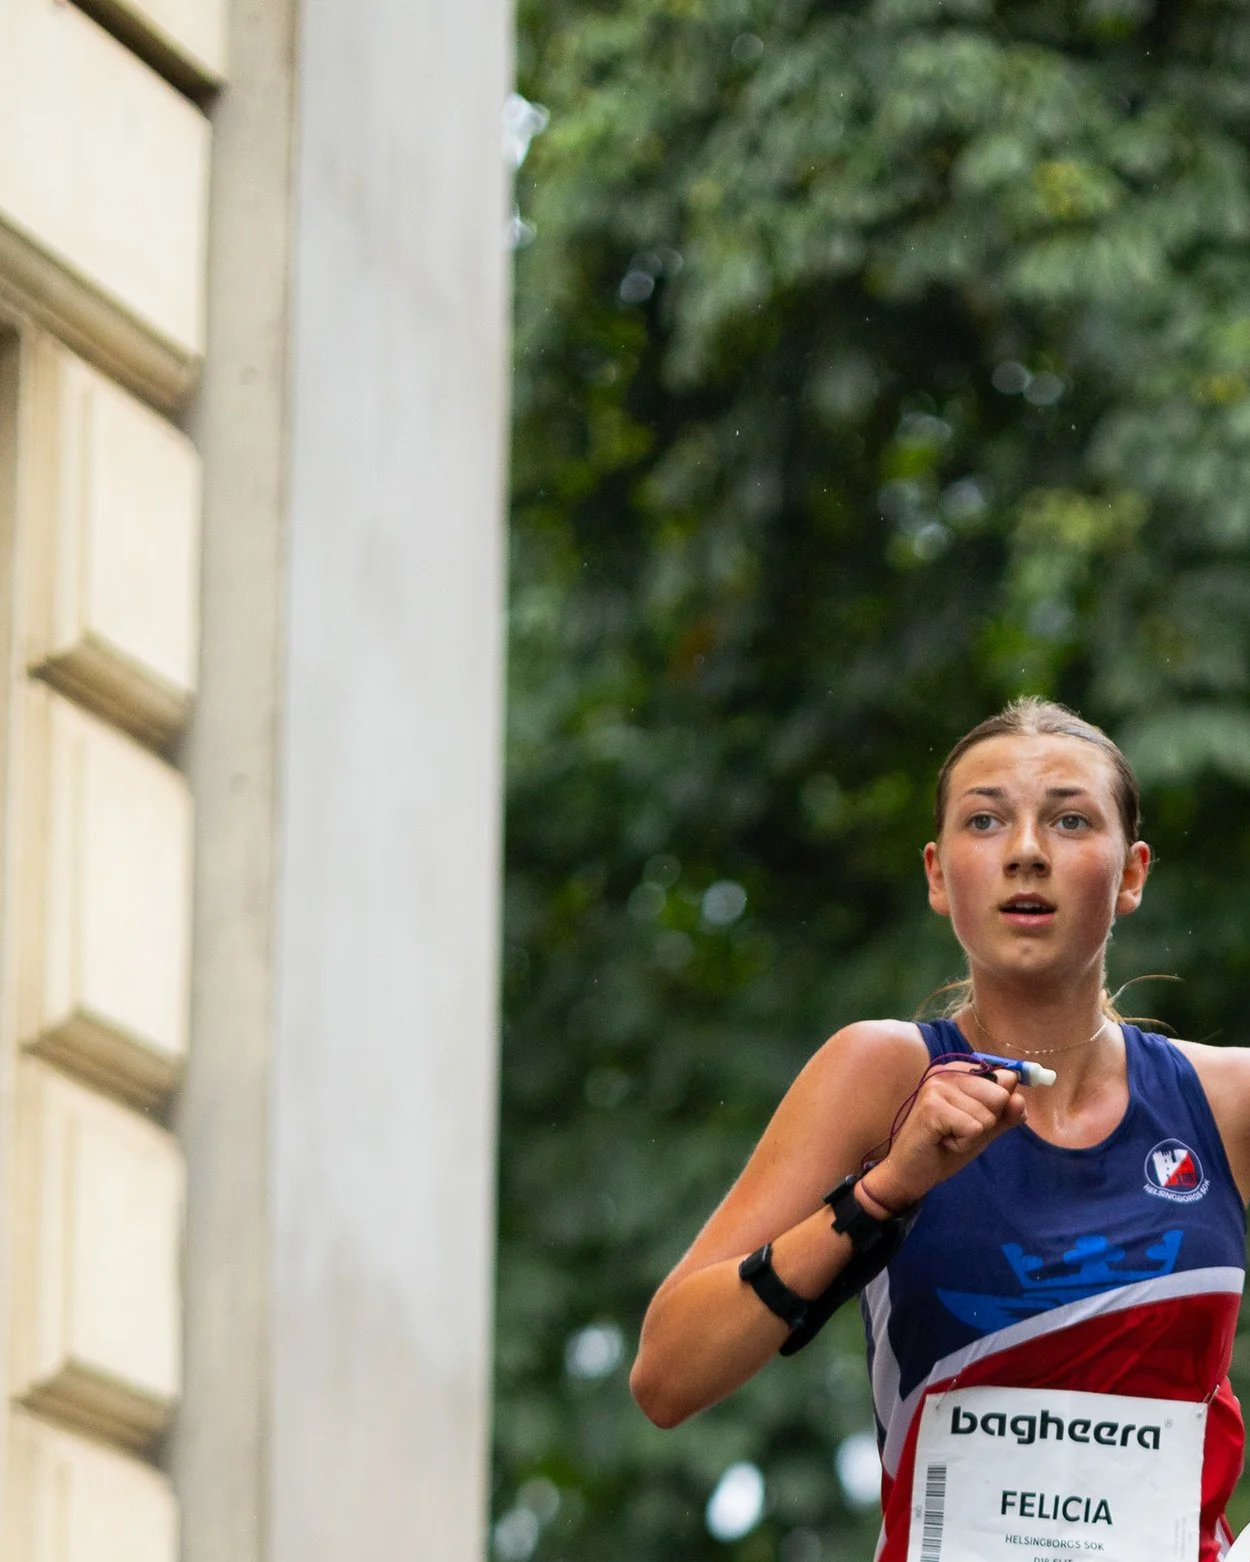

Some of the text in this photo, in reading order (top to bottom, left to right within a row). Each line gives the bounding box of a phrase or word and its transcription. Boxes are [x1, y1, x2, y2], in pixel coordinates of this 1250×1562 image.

[950, 1406, 1161, 1450] bagheera
[1001, 1490, 1113, 1525] FELICIA
[1005, 1534, 1104, 1551] HELSINGBORGS SOK
